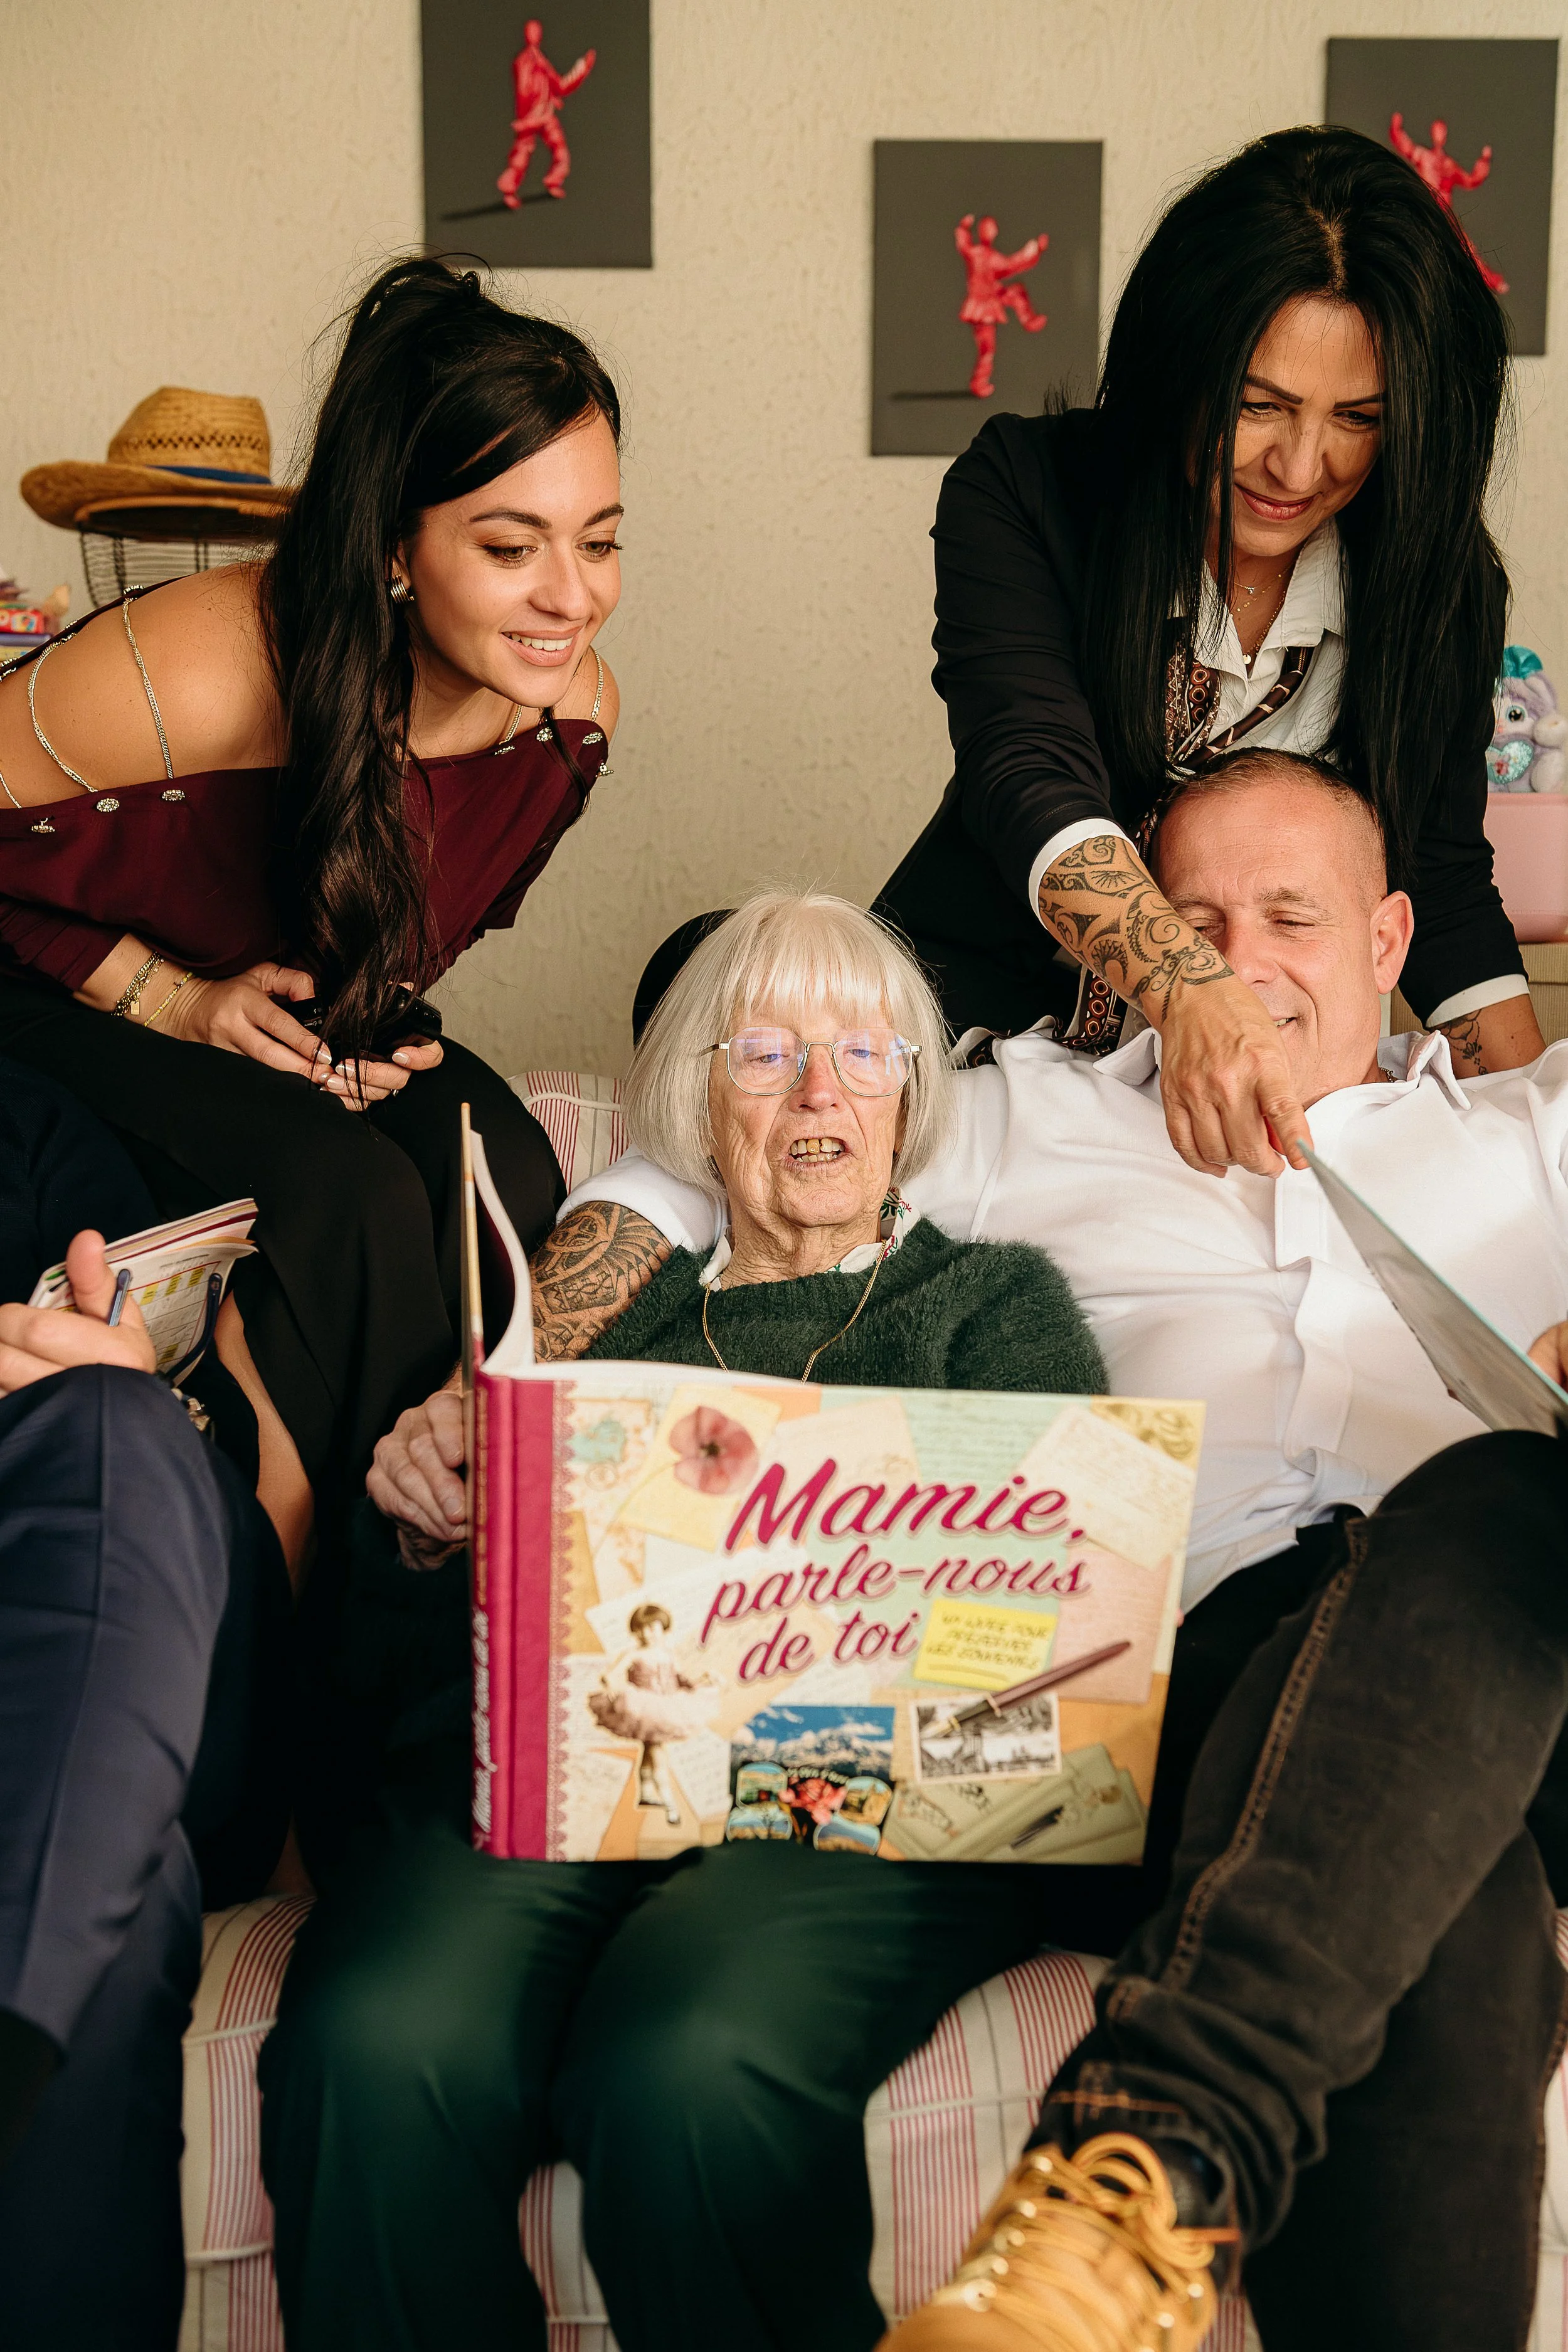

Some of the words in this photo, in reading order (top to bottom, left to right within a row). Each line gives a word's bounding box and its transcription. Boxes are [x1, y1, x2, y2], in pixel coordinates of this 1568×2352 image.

[724, 1458, 1084, 1550] Mamie,
[700, 1544, 1090, 1645] parle-nous
[738, 1616, 815, 1682] de
[833, 1610, 920, 1662] toi
